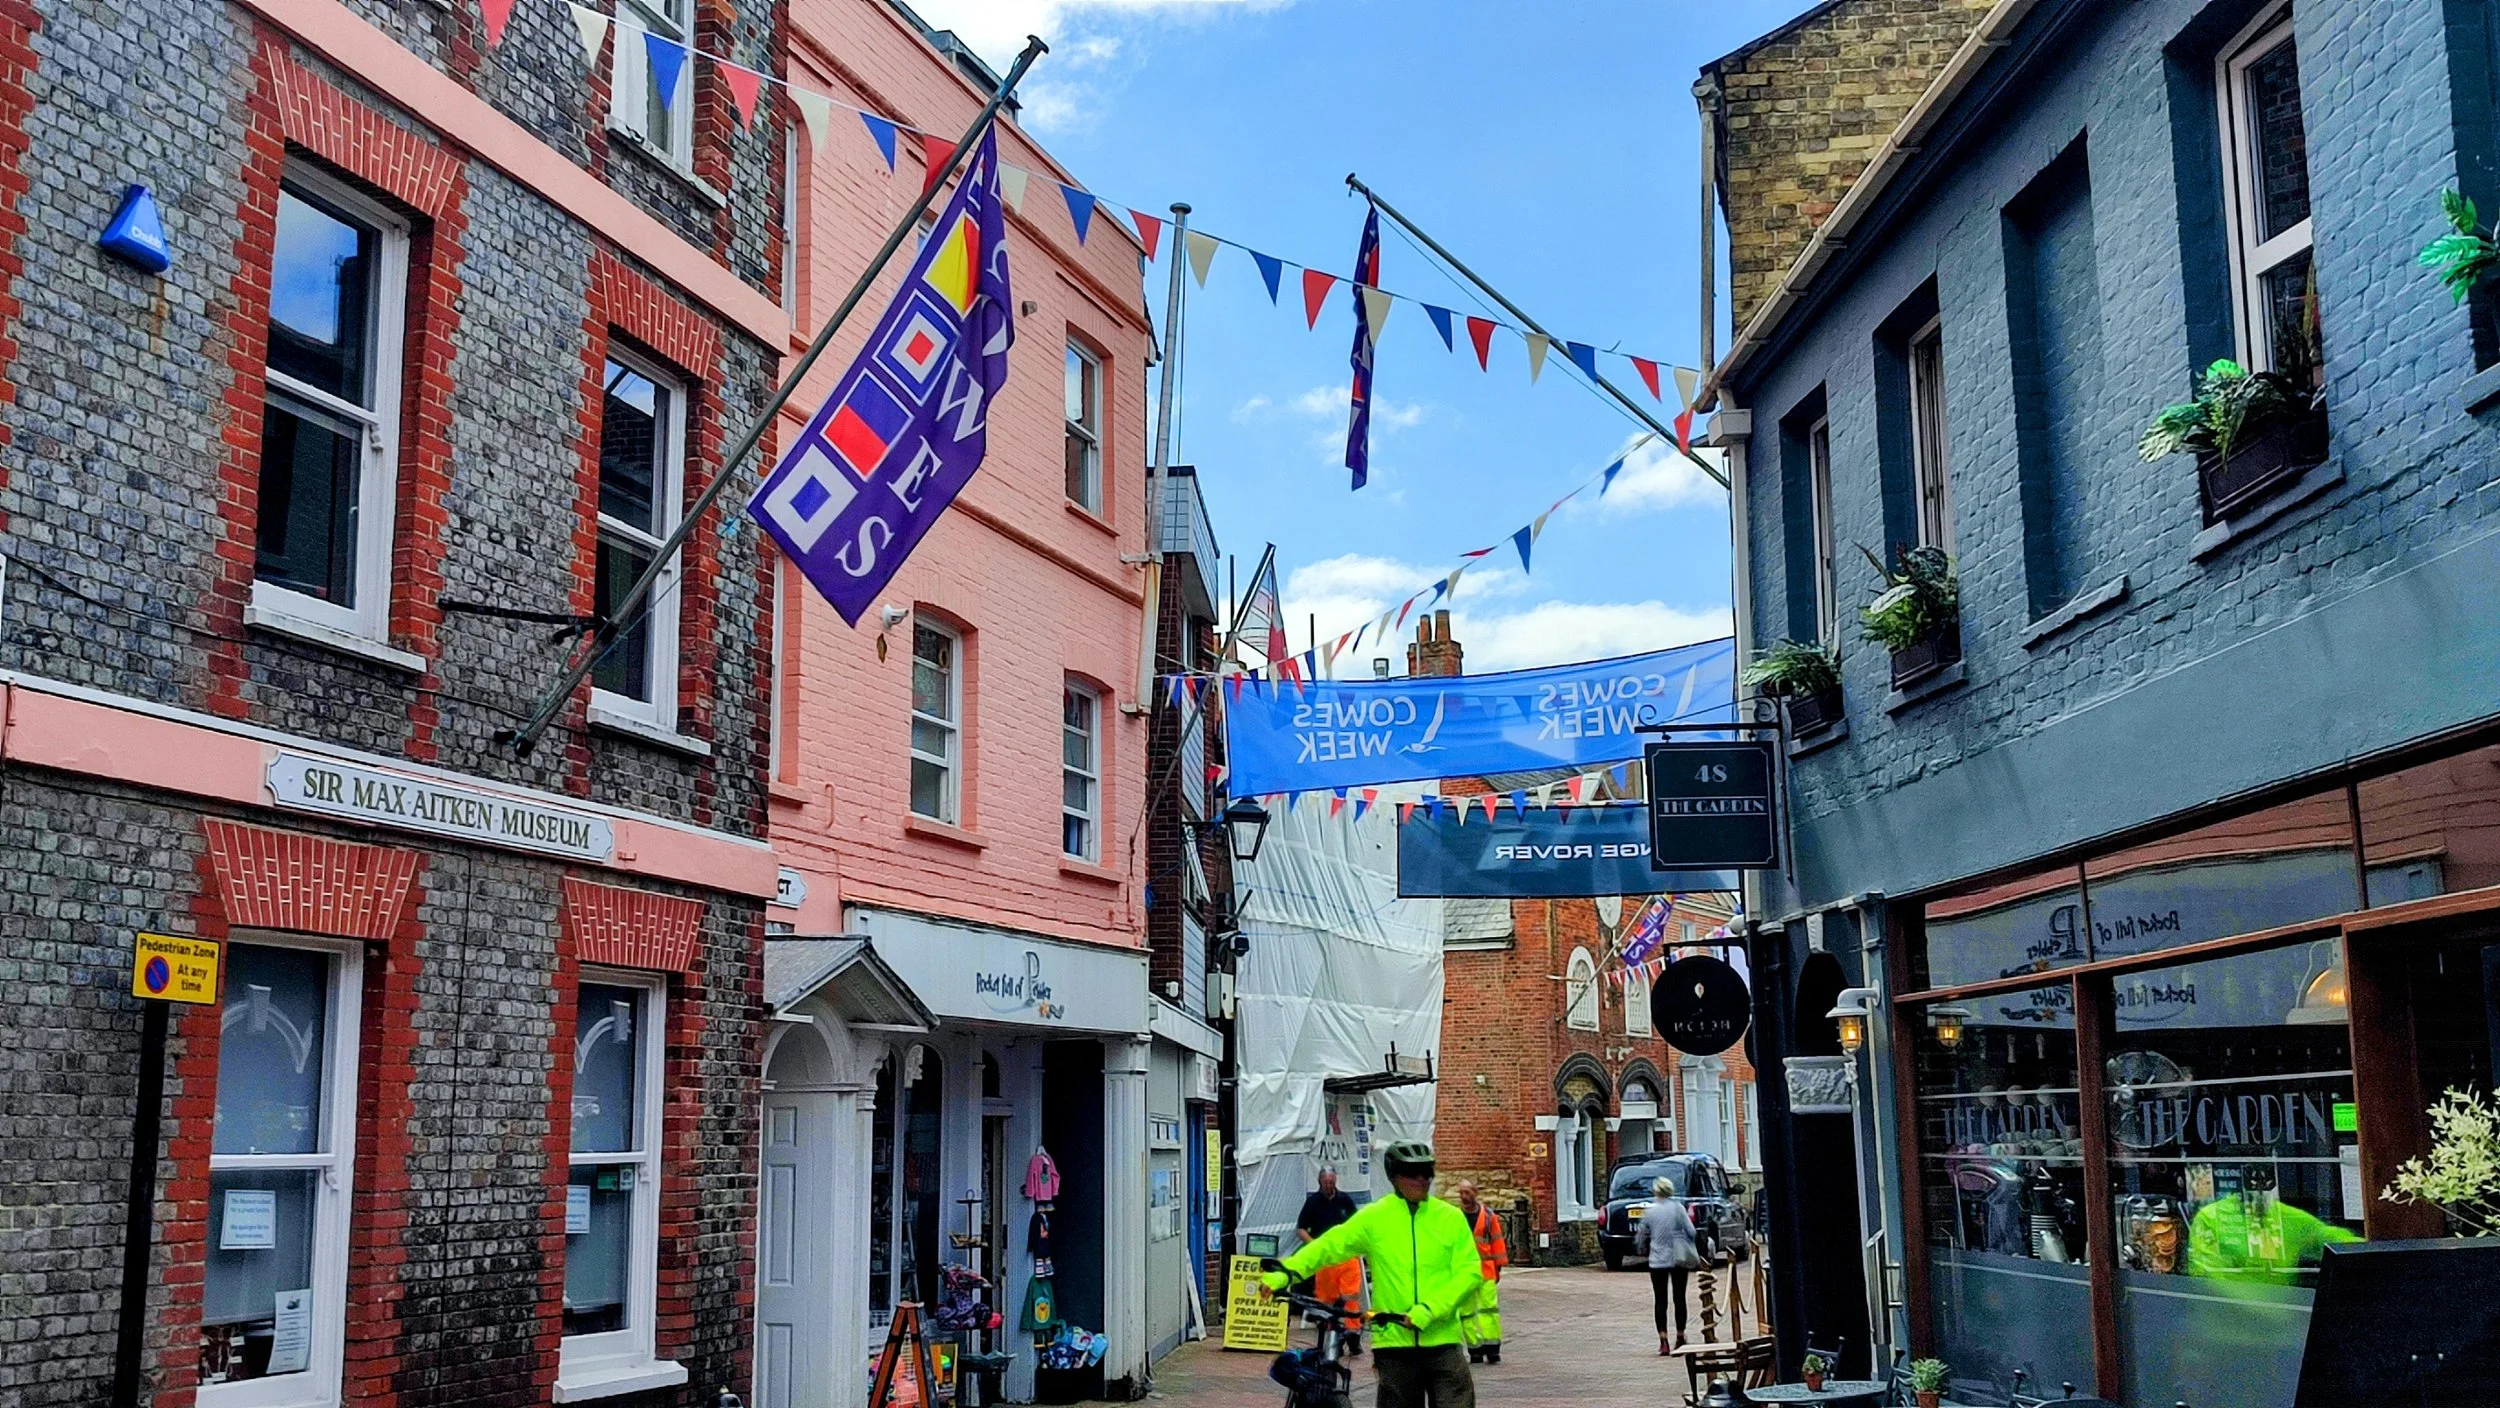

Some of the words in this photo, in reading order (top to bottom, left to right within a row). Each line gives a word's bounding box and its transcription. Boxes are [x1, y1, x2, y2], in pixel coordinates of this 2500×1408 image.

[1694, 764, 1728, 783] 48
[303, 768, 344, 804] SIR
[353, 777, 406, 816] MAX
[411, 790, 493, 832] AITKEN
[501, 807, 591, 850] MUSEUM
[1662, 801, 1692, 814] THE
[1695, 799, 1766, 813] GARDEN
[140, 938, 191, 955] Pedestrian
[193, 944, 216, 959] Zone
[177, 963, 189, 976] At
[191, 967, 208, 980] any
[181, 979, 202, 992] time
[2139, 1099, 2190, 1148] THE
[2196, 1092, 2327, 1146] GARDEN
[1234, 1297, 1257, 1307] OPEN
[1235, 1307, 1259, 1317] FROM
